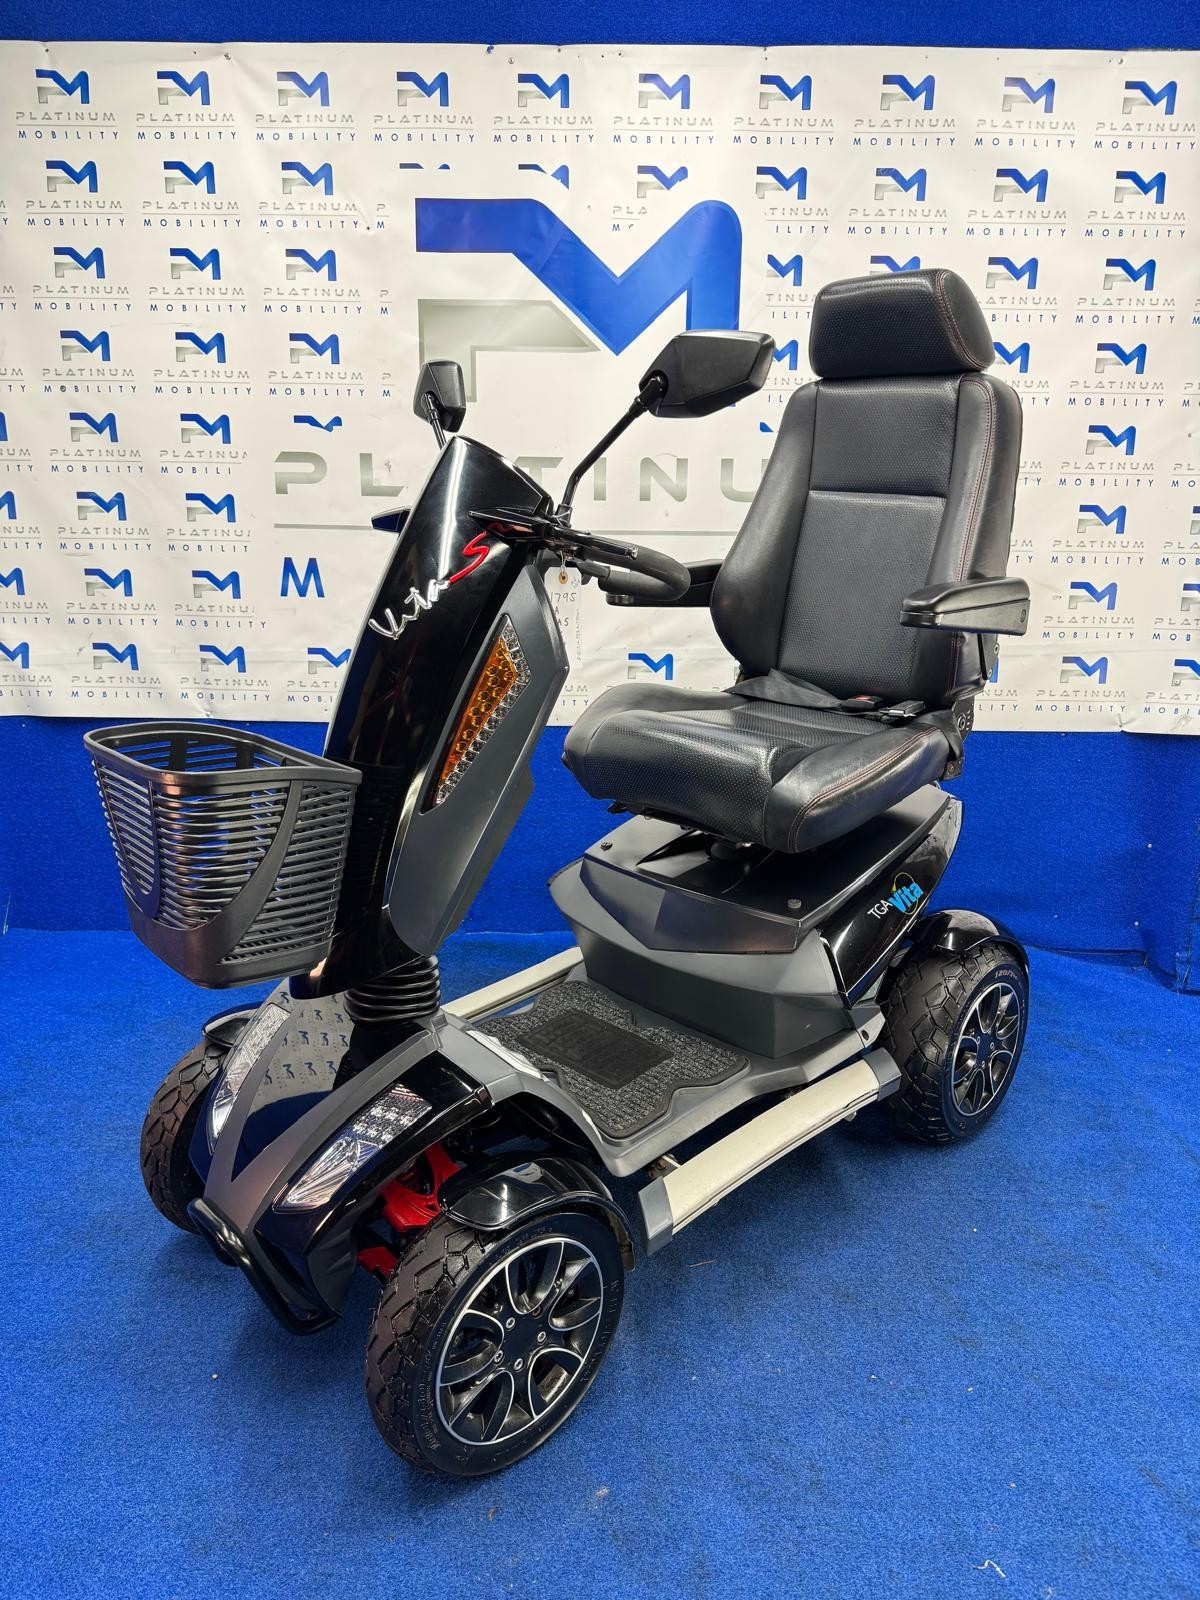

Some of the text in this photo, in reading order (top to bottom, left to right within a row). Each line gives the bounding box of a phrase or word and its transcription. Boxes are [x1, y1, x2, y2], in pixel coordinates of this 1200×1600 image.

[16, 112, 116, 121] PLATINUM
[136, 112, 235, 123] PLATINUM
[256, 114, 354, 123] PLATINUM
[374, 115, 473, 124] PLATINUM
[494, 115, 592, 125] PLATINUM
[614, 115, 712, 126] PLATINUM
[734, 117, 834, 127] PLATINUM
[854, 118, 955, 129] PLATINUM
[975, 119, 1075, 131] PLATINUM
[1096, 122, 1196, 133] PLATINUM
[19, 130, 118, 139] MOBILITY
[138, 131, 236, 140] MOBILITY
[256, 132, 355, 141] MOBILITY
[374, 133, 476, 144] MOBILITY
[494, 134, 594, 143] MOBILITY
[613, 135, 714, 144] MOBILITY
[733, 136, 834, 146] MOBILITY
[853, 137, 955, 146] MOBILITY
[974, 137, 1075, 148] MOBILITY
[1094, 141, 1195, 150] MOBILITY
[26, 201, 122, 209] PLATINUM
[142, 201, 239, 210] PLATINUM
[259, 202, 358, 211] PLATINUM
[848, 208, 947, 218] PLATINUM
[968, 210, 1067, 219] PLATINUM
[1088, 210, 1185, 221] PLATINUM
[28, 218, 124, 227] MOBILITY
[144, 219, 240, 227] MOBILITY
[260, 219, 358, 229] MOBILITY
[848, 226, 947, 235] MOBILITY
[966, 227, 1066, 237] MOBILITY
[1085, 229, 1185, 238] MOBILITY
[32, 286, 129, 295] PLATINUM
[149, 287, 244, 295] PLATINUM
[264, 288, 360, 297] PLATINUM
[35, 302, 131, 311] MOBILITY
[1075, 297, 1175, 307] PLATINUM
[150, 304, 246, 312] MOBILITY
[265, 305, 361, 314] MOBILITY
[1075, 315, 1174, 324] MOBILITY
[42, 368, 134, 376] PLATINUM
[154, 369, 250, 380] PLATINUM
[268, 371, 363, 381] PLATINUM
[1070, 381, 1164, 389] PLATINUM
[155, 386, 251, 396] MOBILITY
[269, 388, 364, 397] MOBILITY
[1068, 397, 1164, 407] MOBILITY
[49, 449, 141, 458] PLATINUM
[51, 464, 143, 473] MOBILITY
[161, 466, 230, 475] MOBILI
[1061, 462, 1154, 470] PLATINUM
[1059, 478, 1153, 487] MOBILITY
[57, 528, 149, 536] PLATINUM
[60, 542, 151, 551] MOBILITY
[168, 544, 248, 552] MOBILIT
[1052, 540, 1144, 548] PLATINUM
[1051, 555, 1144, 564] MOBILITY
[66, 603, 156, 611] PLATINUM
[68, 617, 158, 626] MOBILITY
[176, 619, 266, 628] MOBILITY
[1044, 616, 1135, 624] PLATINUM
[1042, 632, 1134, 640] MOBILITY
[71, 675, 161, 684] PLATINUM
[180, 677, 268, 686] PLATINUM
[70, 690, 163, 699] MOBILITY
[181, 692, 270, 700] MOBILITY
[1036, 690, 1126, 698] PLATINUM
[1035, 705, 1126, 713] MOBILITY
[867, 882, 924, 919] TGA Vita
